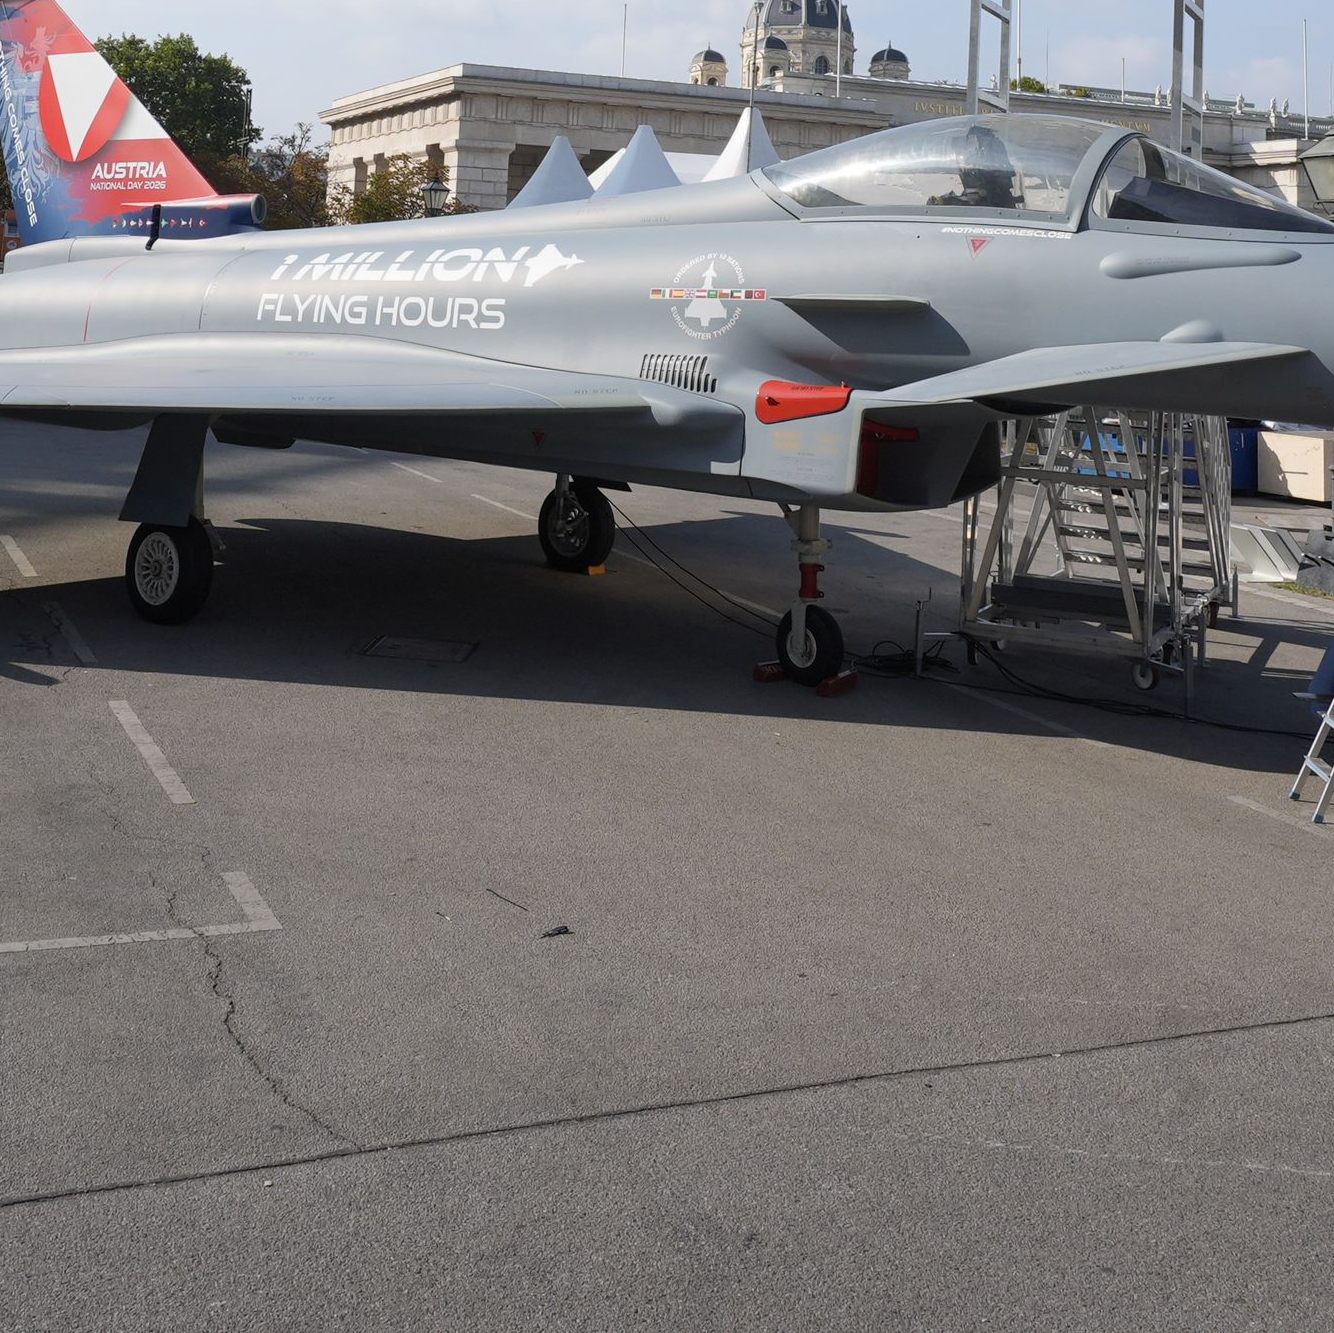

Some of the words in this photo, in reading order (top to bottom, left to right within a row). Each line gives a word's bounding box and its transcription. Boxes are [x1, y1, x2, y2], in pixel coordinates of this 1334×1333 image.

[914, 101, 965, 116] IVSTITI
[7, 103, 25, 165] COMES
[20, 167, 38, 227] CLOSE
[91, 161, 167, 180] AUSTRIA
[90, 181, 126, 191] NATIONAL
[127, 181, 143, 190] DAY
[144, 180, 167, 190] 2026
[940, 227, 1073, 240] #NOTHINGCOMESCLOSE
[269, 254, 299, 281] 1
[291, 245, 531, 283] MILLION
[673, 254, 706, 284] ORDERED
[707, 252, 718, 260] BY
[726, 256, 745, 284] NATIONS
[256, 293, 369, 324] FLYING
[375, 295, 507, 330] HOURS
[670, 305, 712, 340] EUROFIGHTER
[713, 306, 743, 339] TYPHOON
